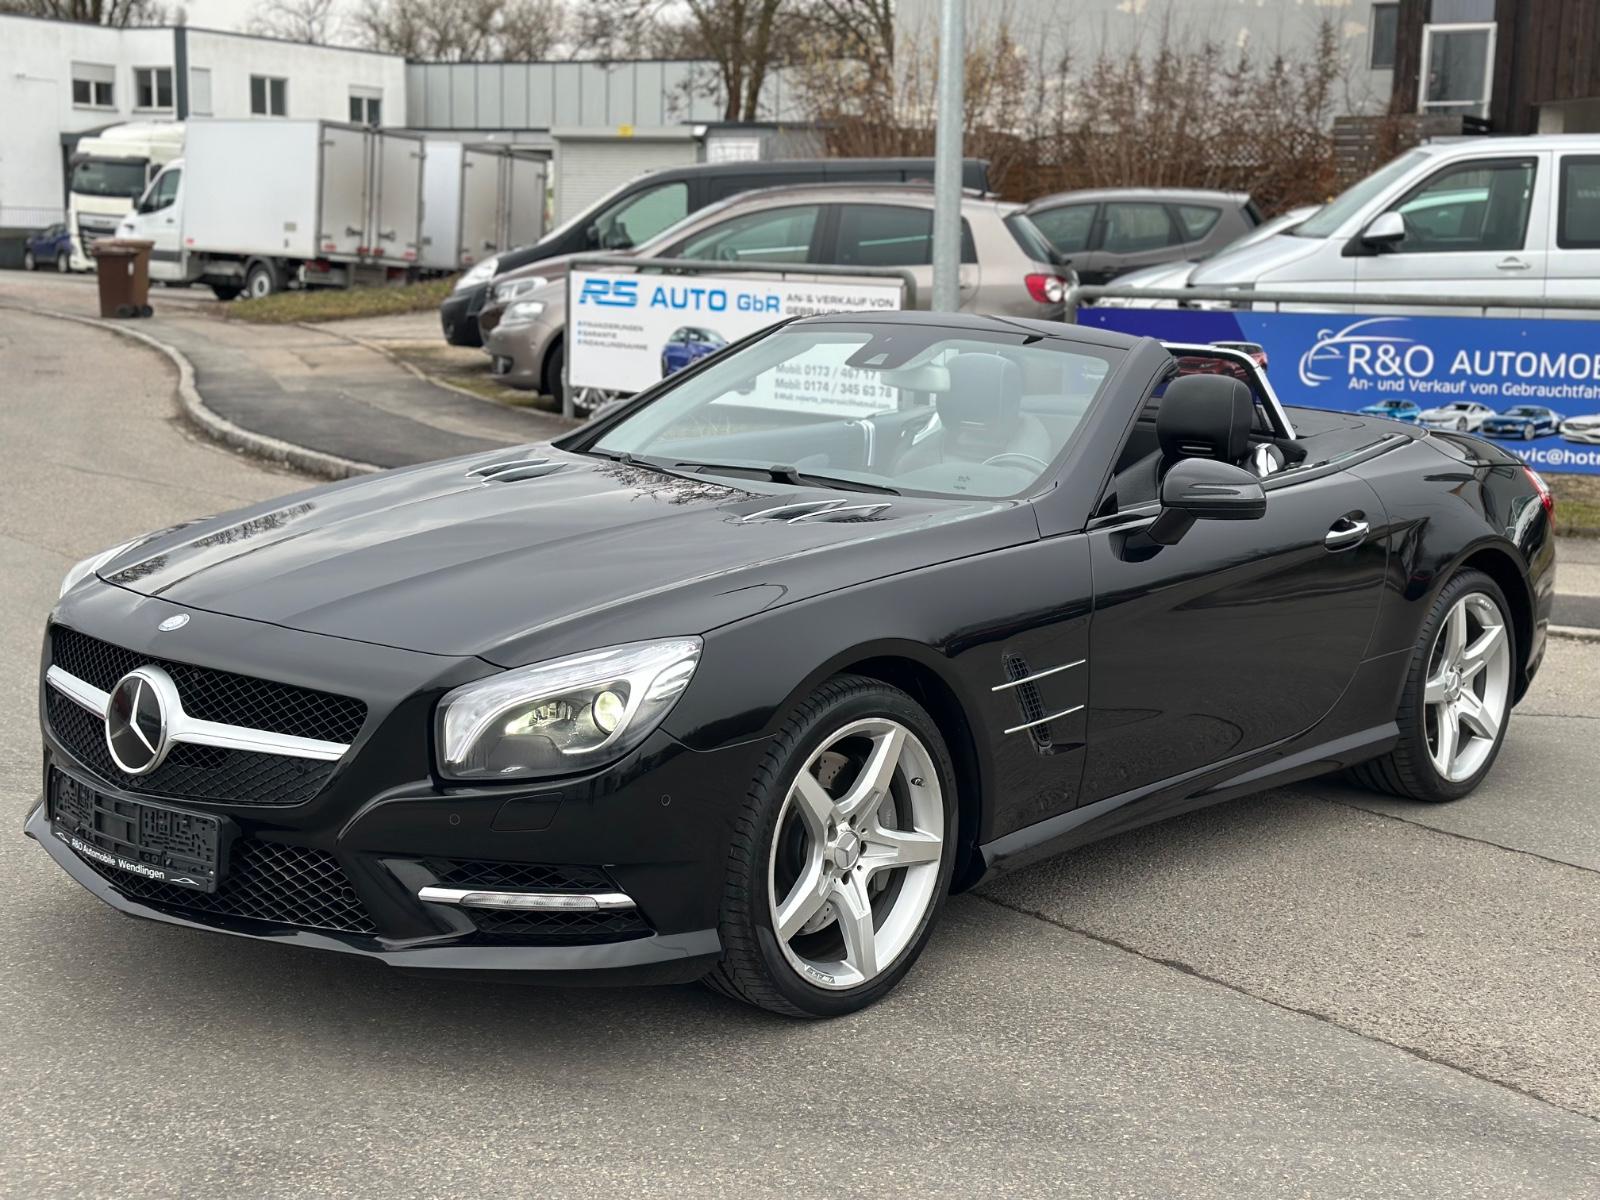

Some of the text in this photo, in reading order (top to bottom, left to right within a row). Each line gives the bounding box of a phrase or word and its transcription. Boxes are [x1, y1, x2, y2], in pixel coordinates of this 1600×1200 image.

[650, 286, 727, 312] AUTO
[737, 293, 781, 314] GbR
[815, 295, 867, 306] VERKAUF
[869, 298, 894, 308] VON
[1347, 343, 1434, 377] R&O
[803, 380, 829, 392] 0174
[840, 383, 860, 395] 345
[862, 384, 876, 397] 63
[1348, 376, 1374, 391] An-
[1377, 377, 1404, 392] und
[1409, 379, 1466, 394] Verkauf
[1469, 382, 1498, 396] von
[82, 844, 116, 866] Automobile
[118, 859, 165, 880] Wendlingen
